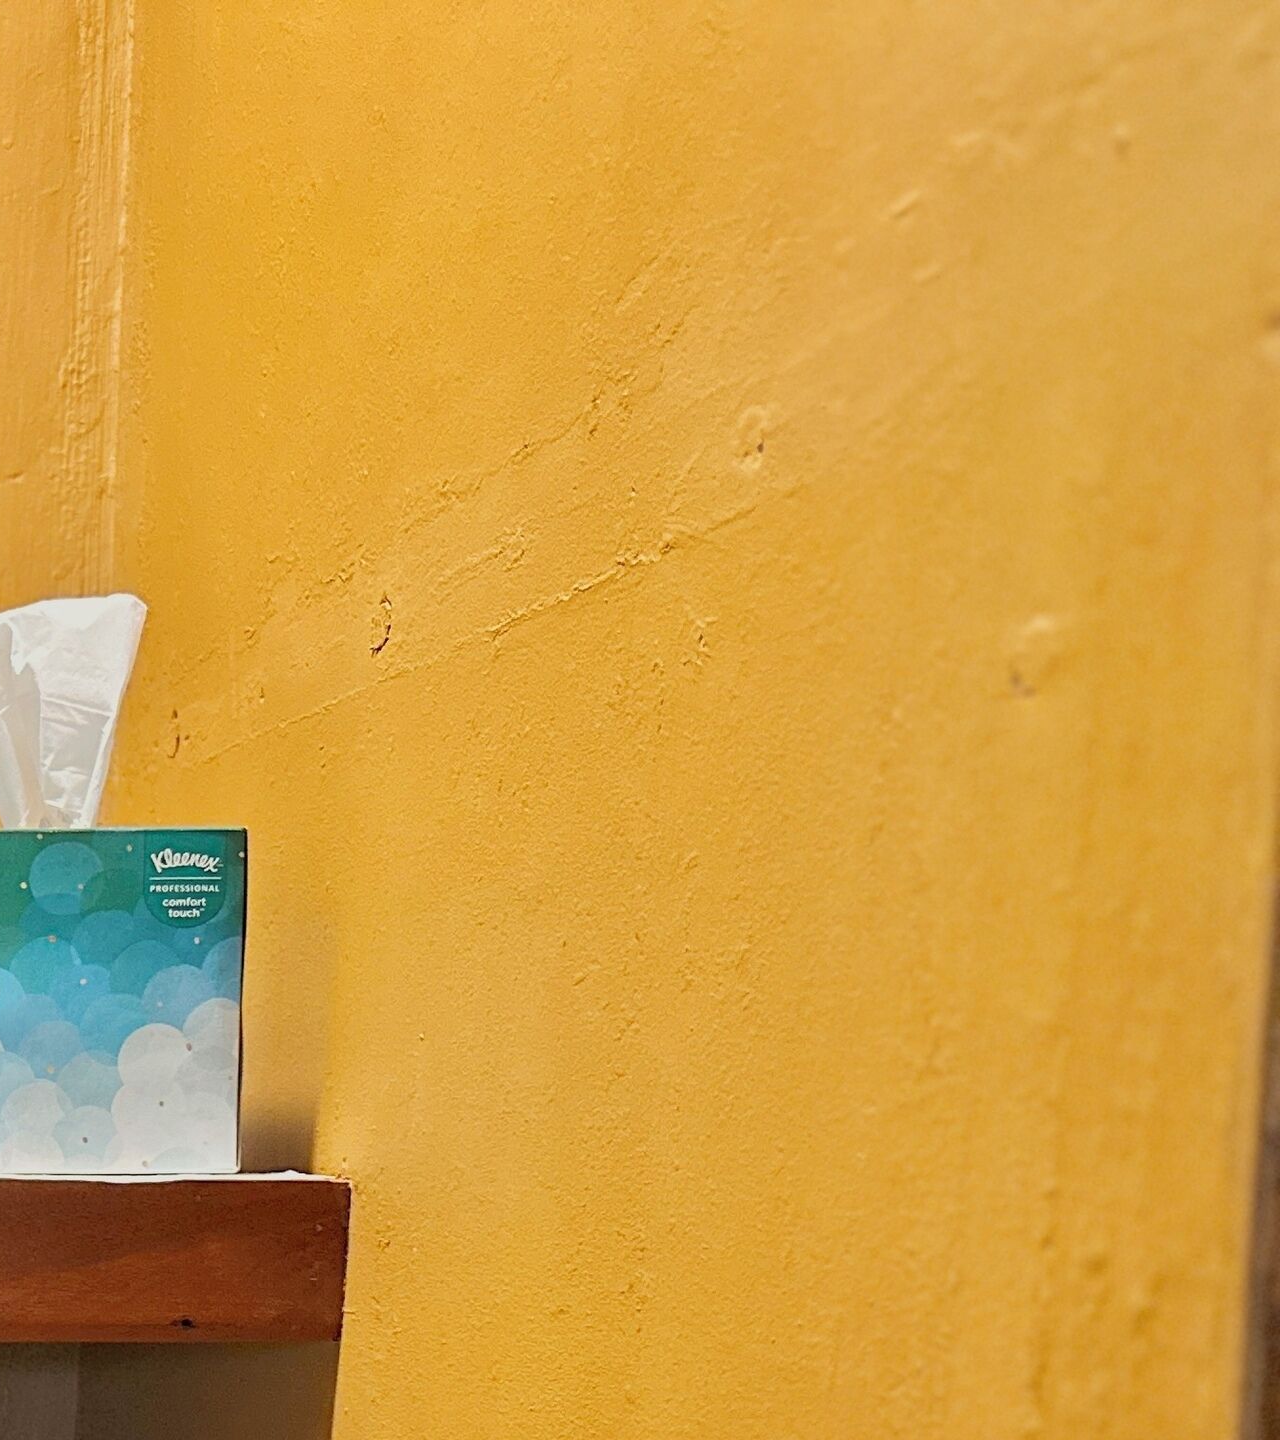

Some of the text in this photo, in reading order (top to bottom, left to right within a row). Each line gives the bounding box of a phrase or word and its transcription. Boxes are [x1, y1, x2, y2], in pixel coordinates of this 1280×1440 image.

[151, 848, 220, 873] Kleenex
[149, 884, 220, 893] PROFESSIONAL
[162, 897, 207, 907] comfort
